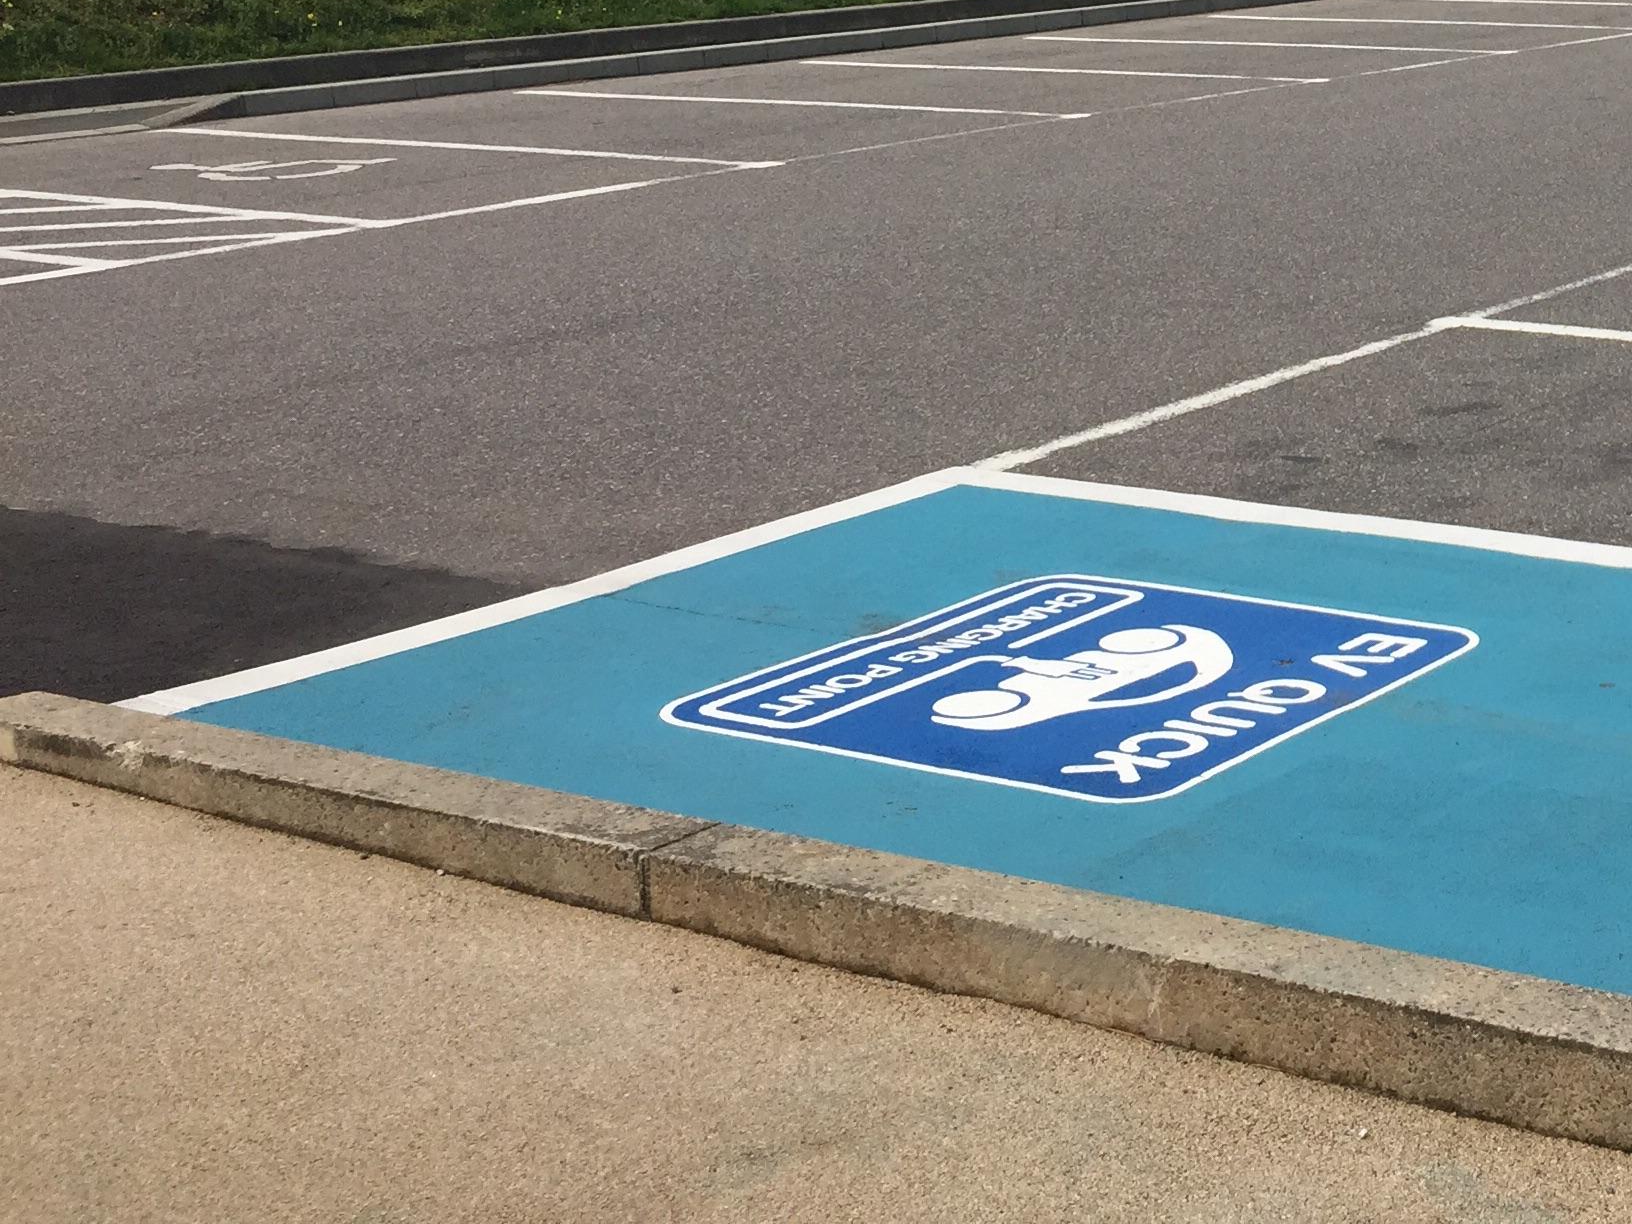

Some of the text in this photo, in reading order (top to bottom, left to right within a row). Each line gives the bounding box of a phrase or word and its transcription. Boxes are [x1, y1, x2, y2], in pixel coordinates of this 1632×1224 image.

[759, 591, 1098, 717] CHARGING POINT
[1060, 632, 1428, 783] EV QUICK
